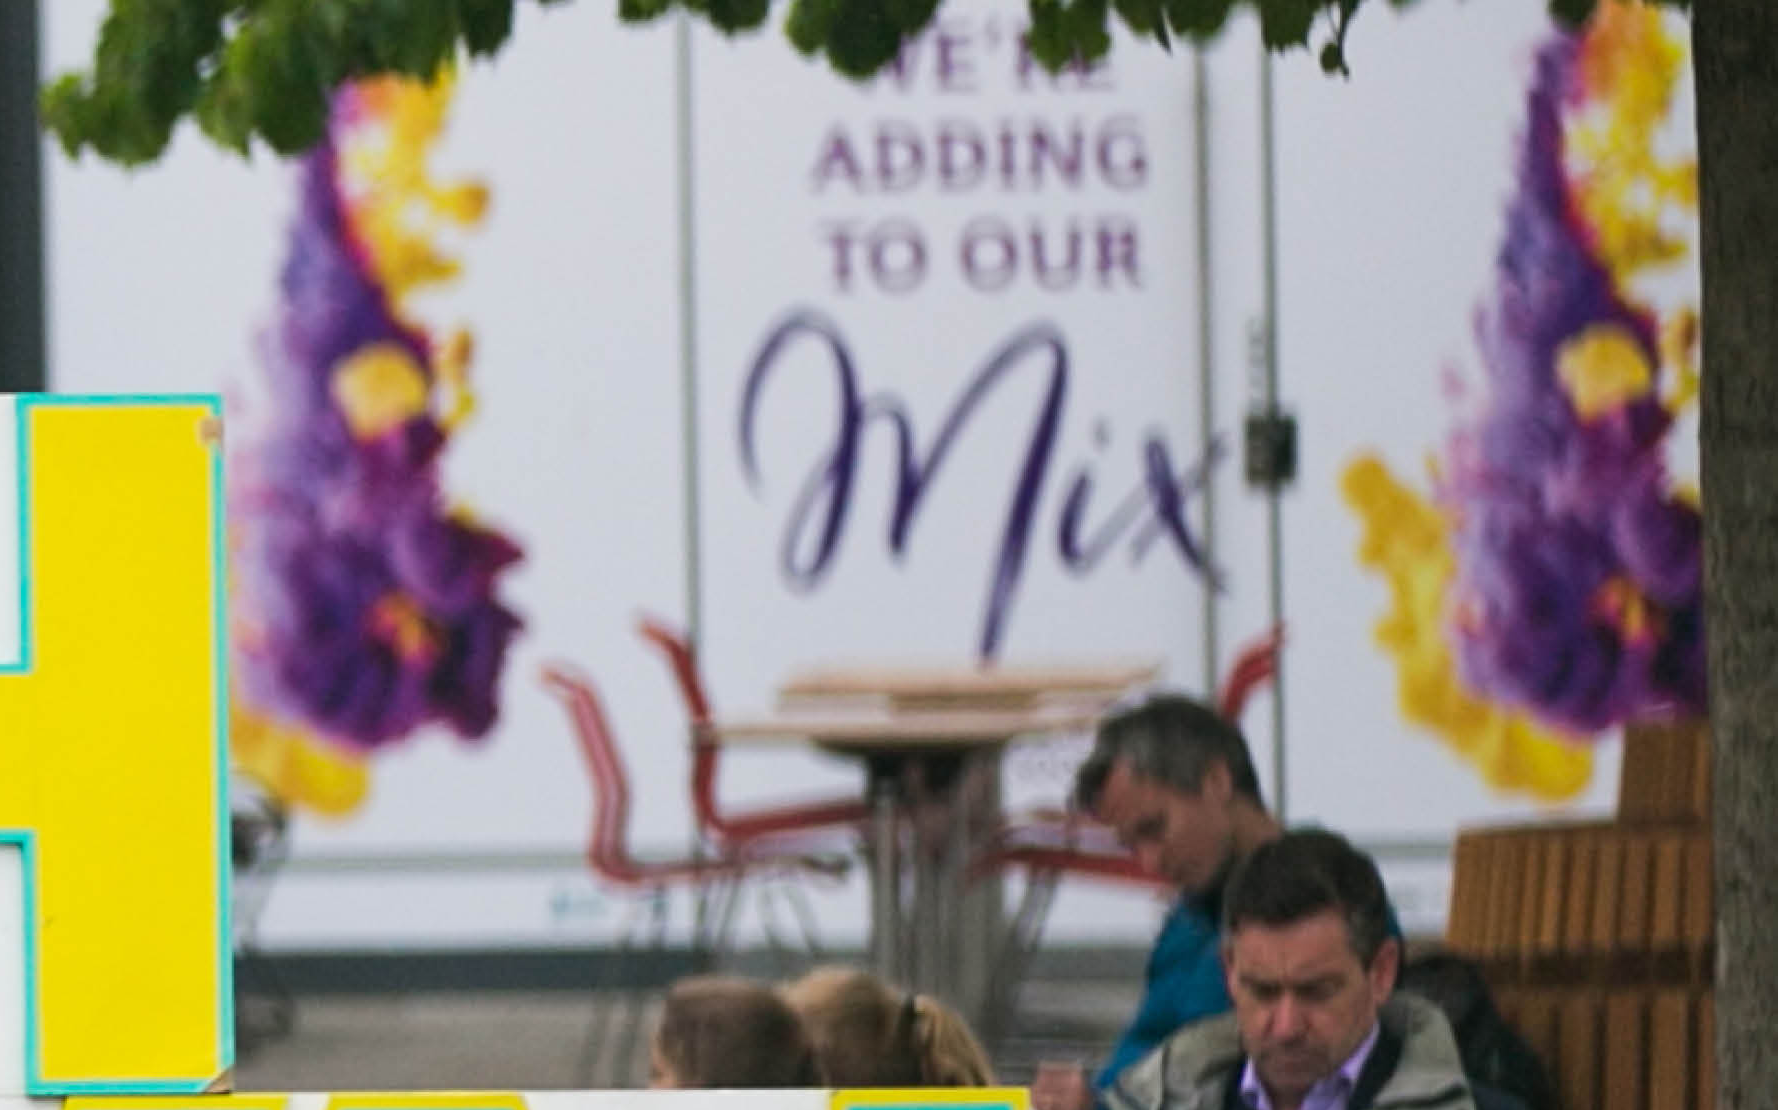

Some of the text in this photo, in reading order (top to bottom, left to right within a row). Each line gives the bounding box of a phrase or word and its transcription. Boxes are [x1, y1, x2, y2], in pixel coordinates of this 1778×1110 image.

[811, 116, 1149, 196] ADDING
[818, 214, 1144, 294] TO OUR
[737, 306, 1229, 668] Mix
